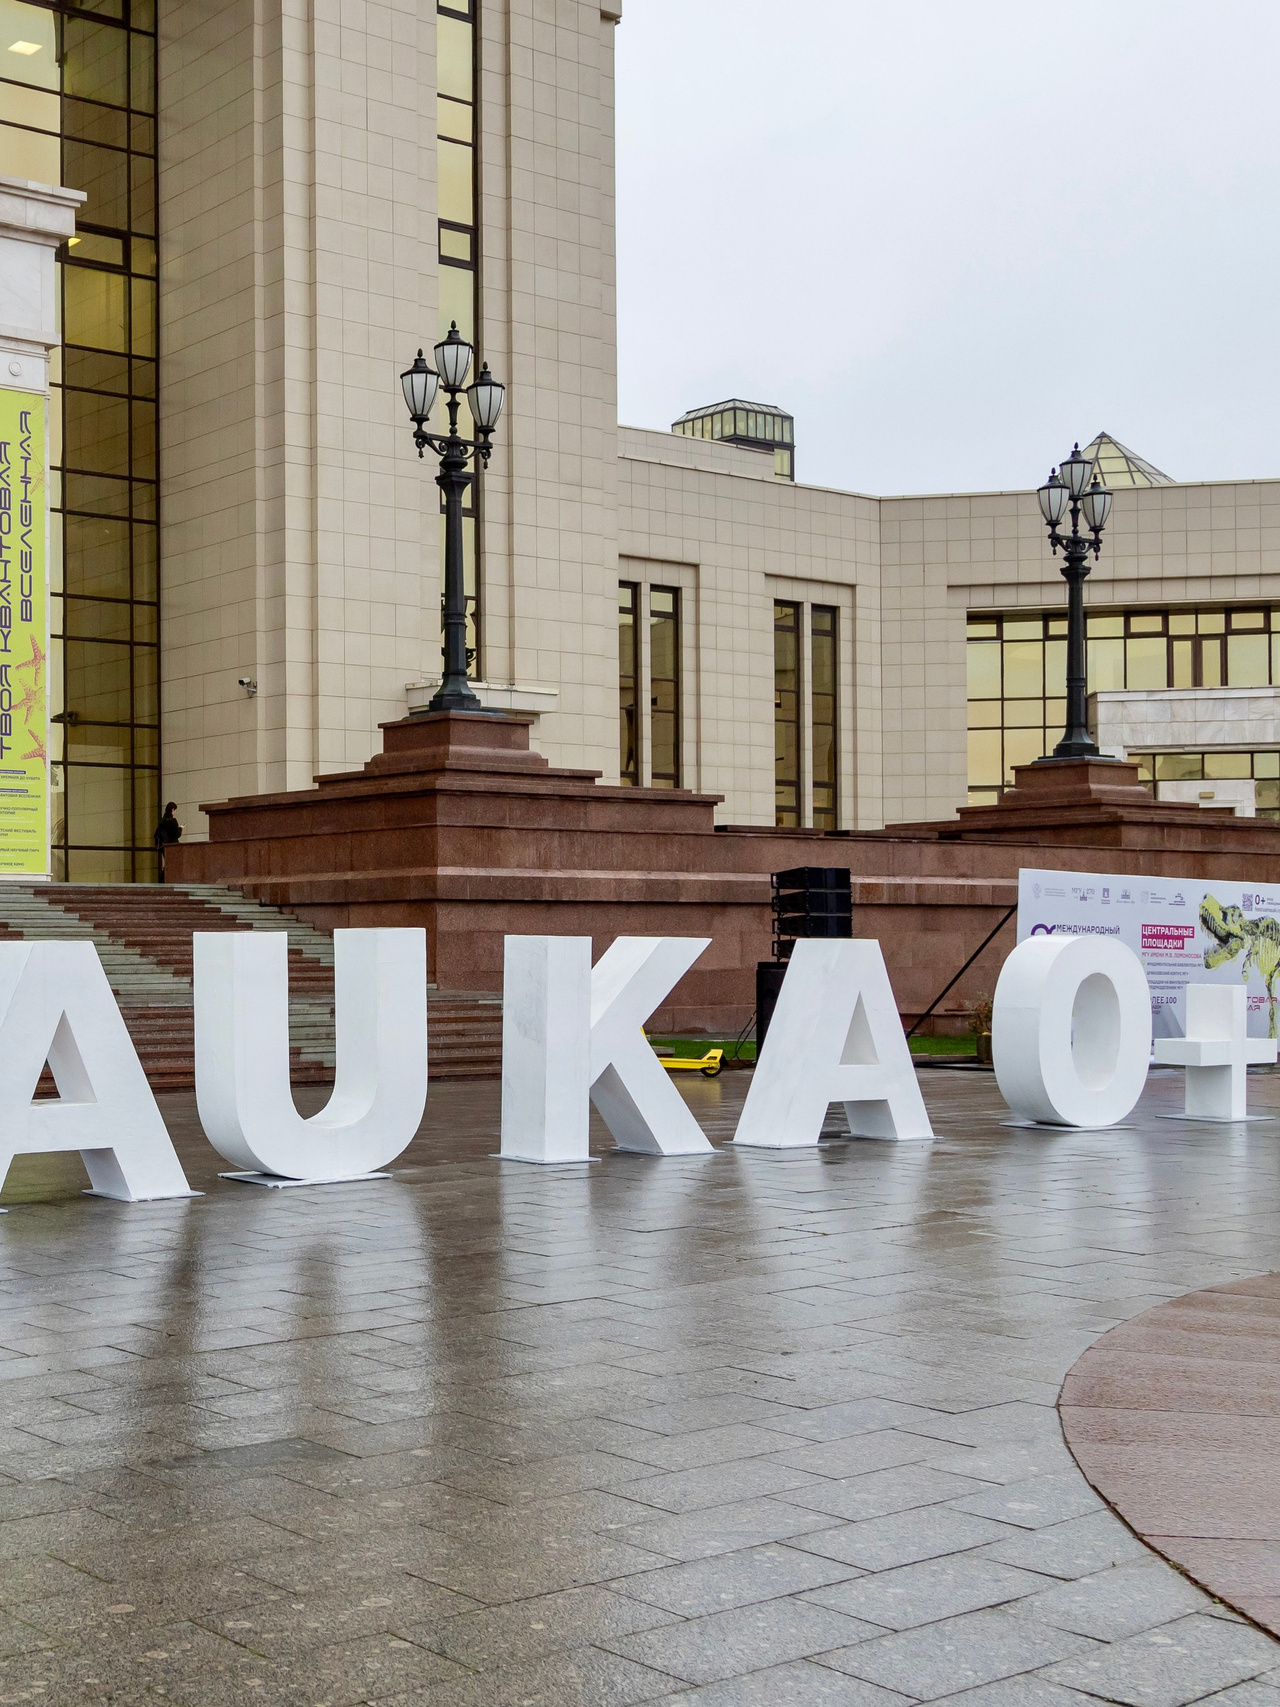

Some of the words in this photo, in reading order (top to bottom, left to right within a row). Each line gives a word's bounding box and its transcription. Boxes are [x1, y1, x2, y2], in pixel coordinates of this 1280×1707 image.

[20, 411, 33, 622] ВСЕЛЕННАЯ
[0, 441, 12, 653] КВАНТОВАЯ
[0, 665, 12, 760] ТВОЯ
[1056, 923, 1120, 935] МЕЖДУНАРОДНЫЙ
[1142, 926, 1194, 937] ЦЕНТРАЛЬНЫЕ
[1142, 938, 1183, 949] ПЛОЩАДКИ
[1165, 996, 1178, 1004] 100
